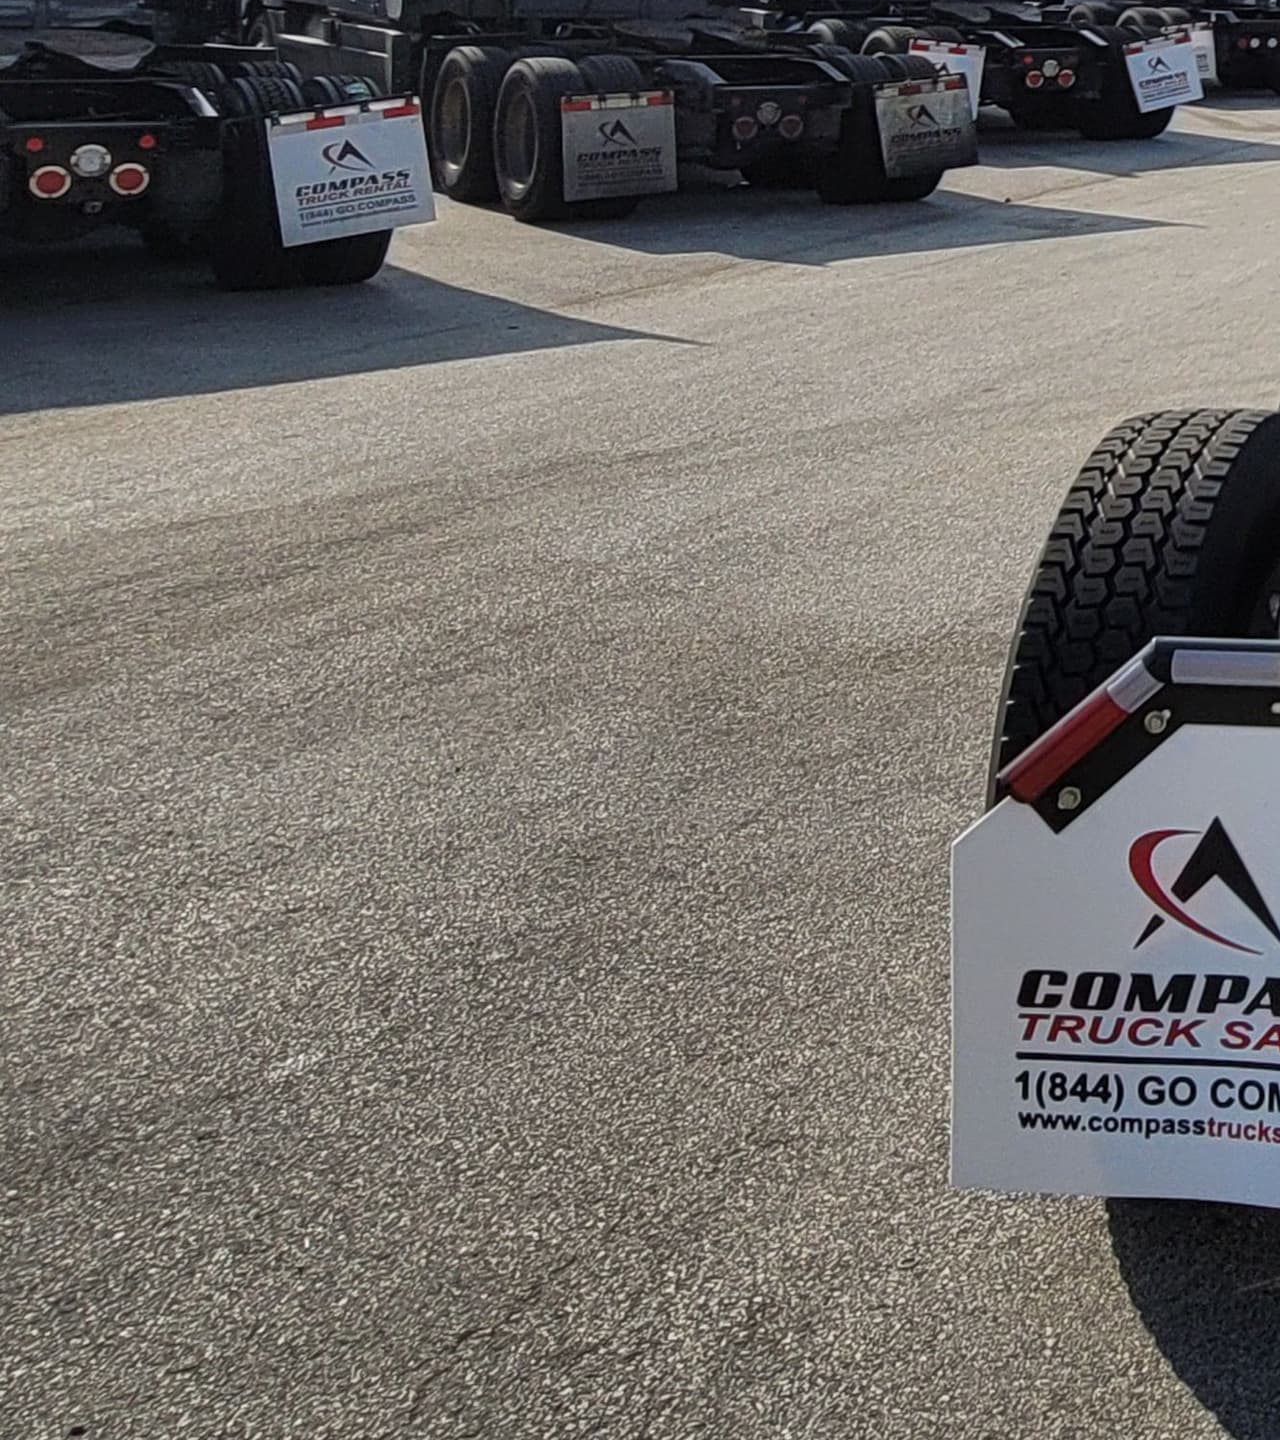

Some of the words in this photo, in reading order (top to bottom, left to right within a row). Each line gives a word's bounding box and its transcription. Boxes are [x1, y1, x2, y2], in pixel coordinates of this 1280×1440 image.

[295, 169, 412, 198] COMPASS
[297, 191, 350, 206] TRUCK
[352, 178, 412, 197] RENTAL
[335, 204, 355, 215] GO
[357, 194, 417, 211] COMPASS
[1017, 1012, 1206, 1048] TRUCK
[1014, 1070, 1124, 1112] 1(844)
[1137, 1075, 1198, 1107] GO
